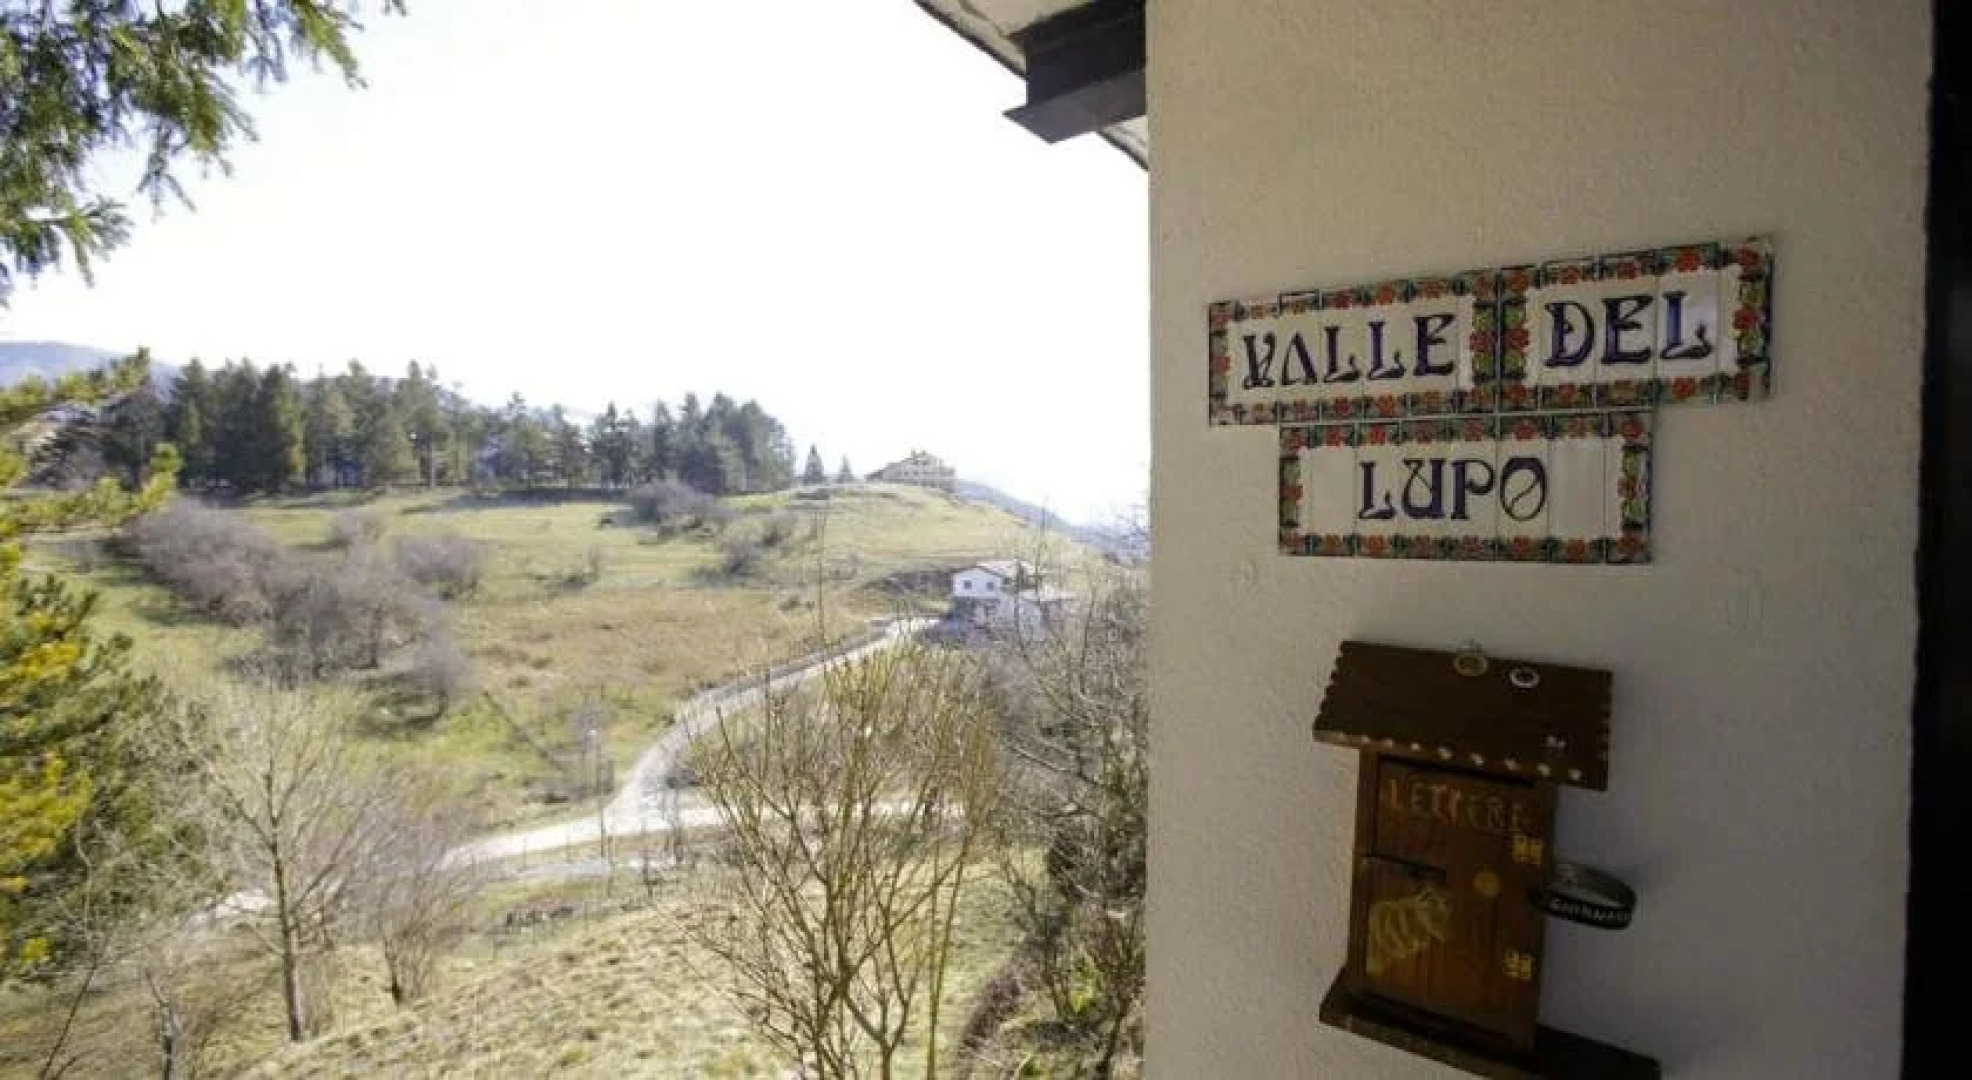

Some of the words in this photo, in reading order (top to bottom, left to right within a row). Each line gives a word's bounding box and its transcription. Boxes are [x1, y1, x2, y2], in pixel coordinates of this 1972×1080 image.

[1242, 313, 1456, 390] VALLE
[1544, 291, 1714, 367] DEL
[1358, 456, 1547, 521] LUPO
